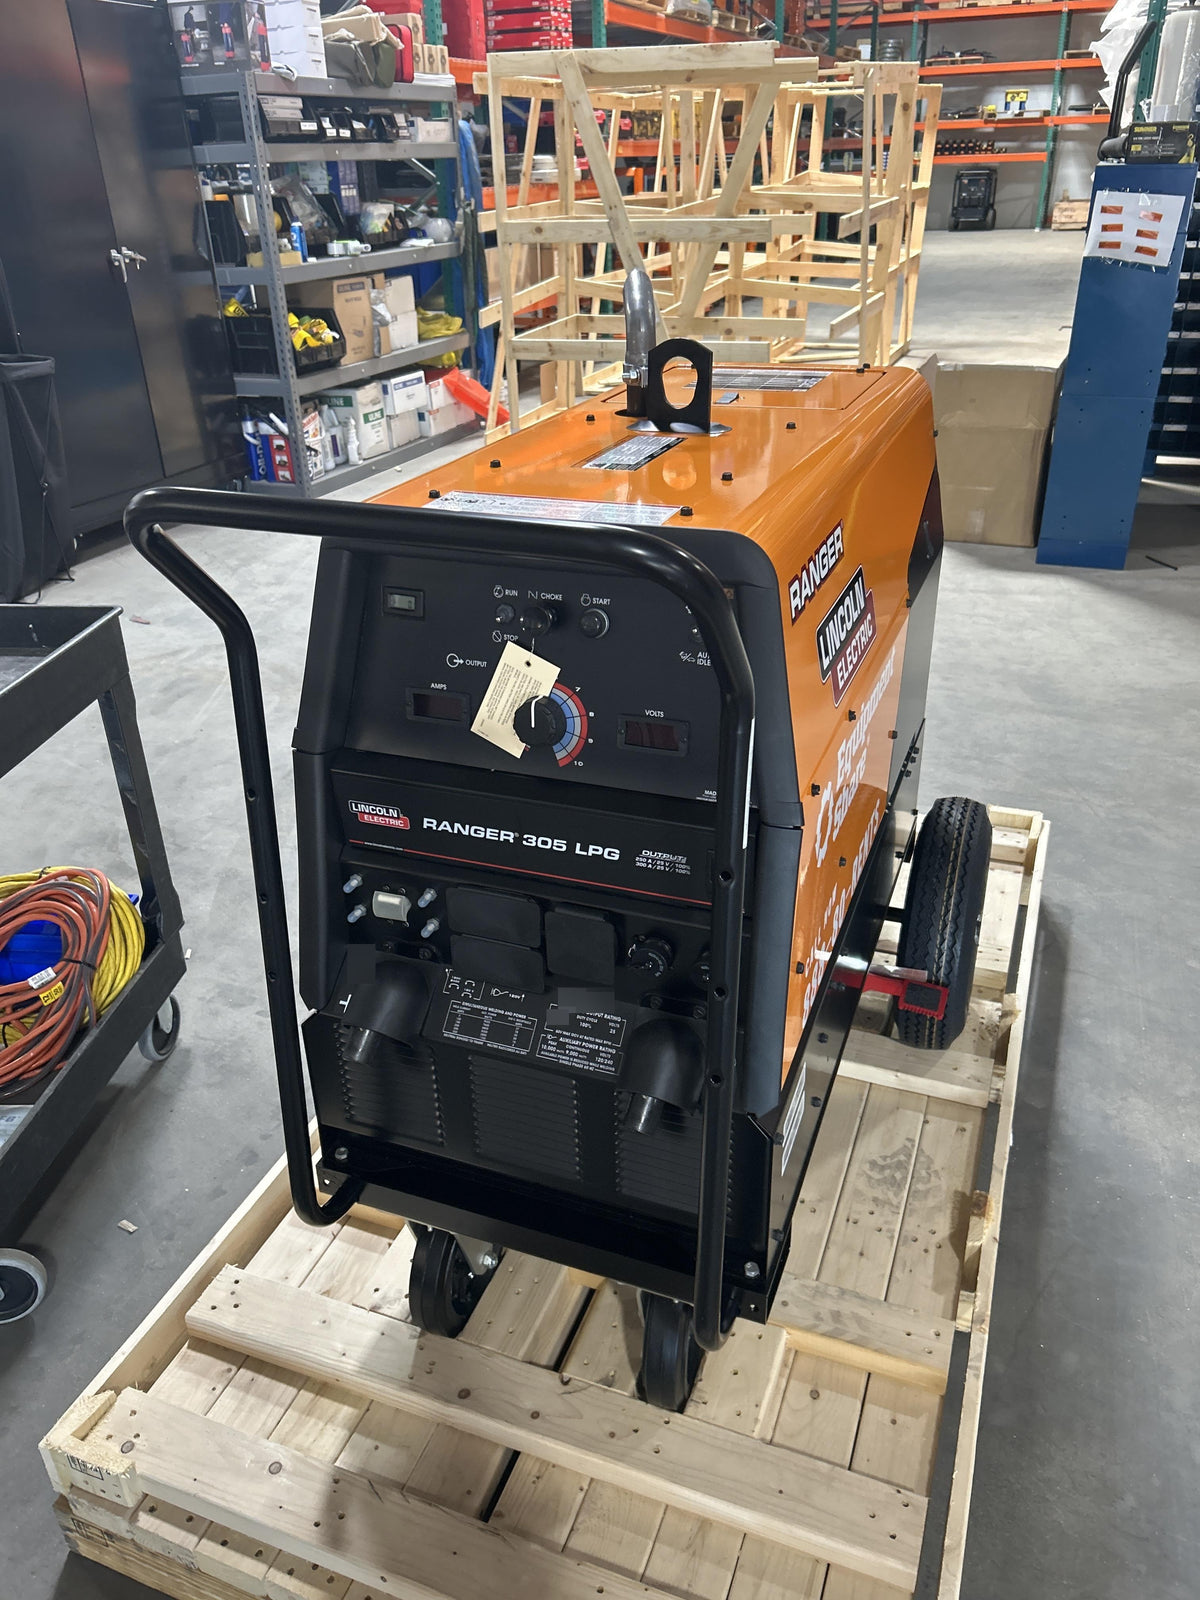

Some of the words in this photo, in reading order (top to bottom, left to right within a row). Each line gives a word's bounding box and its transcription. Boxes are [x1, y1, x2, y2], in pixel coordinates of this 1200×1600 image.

[789, 525, 843, 619] RANGER
[505, 589, 518, 597] RUN
[540, 592, 563, 601] CHOKE
[592, 598, 611, 606] START
[818, 575, 865, 671] LINCOLN
[503, 634, 519, 642] STOP
[836, 614, 873, 691] ELECTRIC
[465, 659, 487, 668] OUTPUT
[696, 658, 711, 667] IDLE
[430, 682, 447, 690] AMPS
[644, 709, 664, 718] VOLTS
[835, 645, 896, 792] Equipment
[833, 746, 868, 842] Share
[351, 802, 398, 818] LINCOLN
[364, 814, 404, 827] ELECTRIC
[423, 817, 515, 843] RANGER
[522, 834, 567, 852] 305
[574, 842, 621, 861] LPG
[604, 1014, 621, 1022] RATING
[560, 1037, 581, 1046] AUXILIARY
[582, 1042, 598, 1050] POWER
[599, 1046, 616, 1054] RATING
